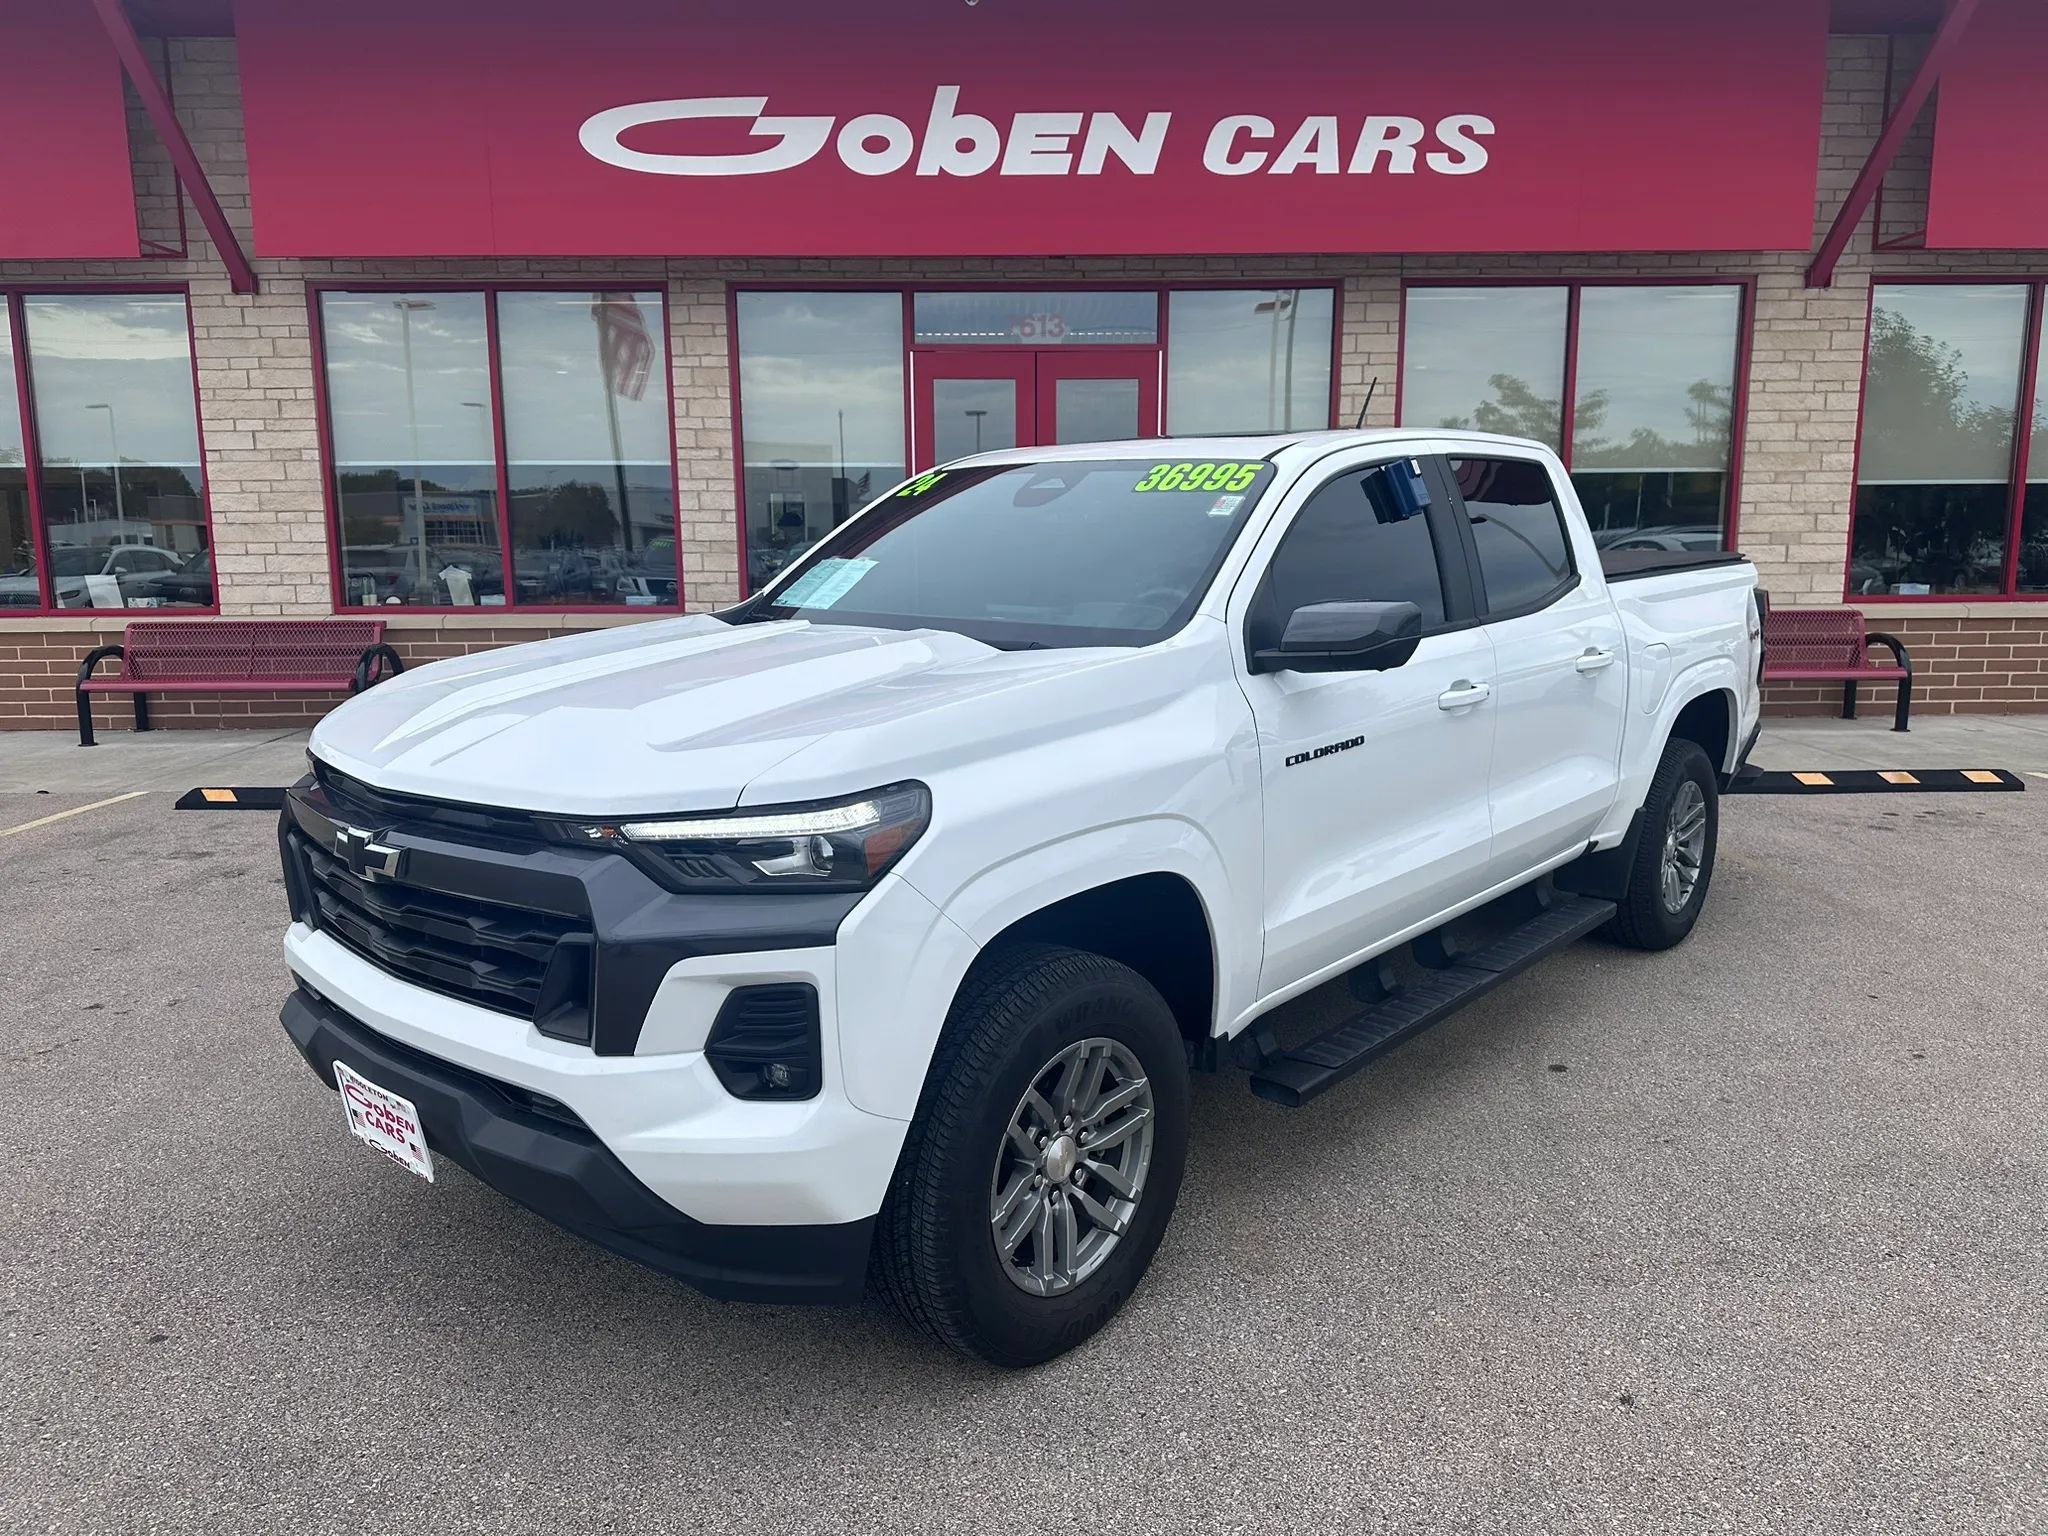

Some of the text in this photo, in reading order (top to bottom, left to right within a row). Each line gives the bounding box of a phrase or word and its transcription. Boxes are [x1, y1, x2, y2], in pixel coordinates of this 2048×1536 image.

[1202, 114, 1496, 176] CARS
[895, 472, 949, 497] 24
[1134, 462, 1265, 492] 36995
[1285, 735, 1365, 767] COLORADO
[365, 1110, 406, 1144] CARS
